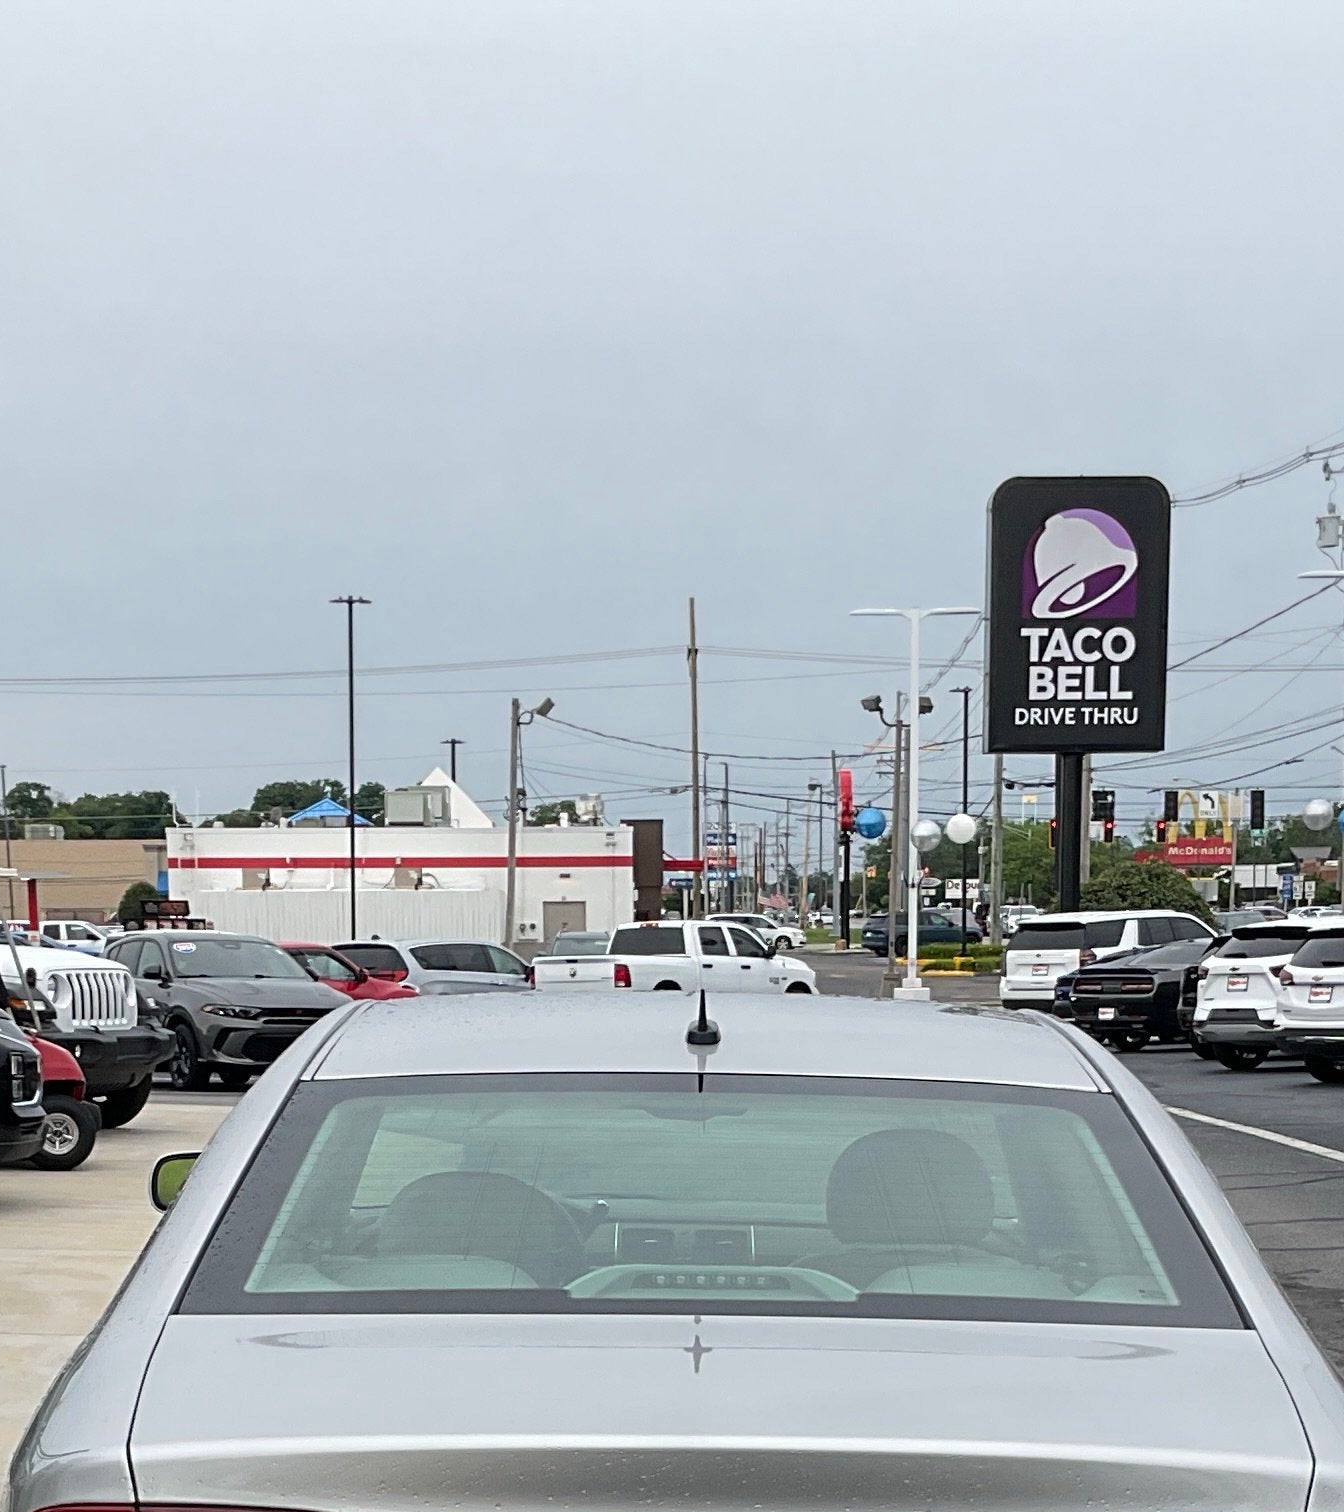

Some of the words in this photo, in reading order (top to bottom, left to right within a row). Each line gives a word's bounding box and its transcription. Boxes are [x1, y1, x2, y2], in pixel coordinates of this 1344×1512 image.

[1020, 627, 1136, 663] TACO
[1028, 666, 1133, 701] BELL
[1014, 708, 1076, 726] DRIVE
[1080, 707, 1139, 725] THRU
[1167, 845, 1232, 856] McDonald's
